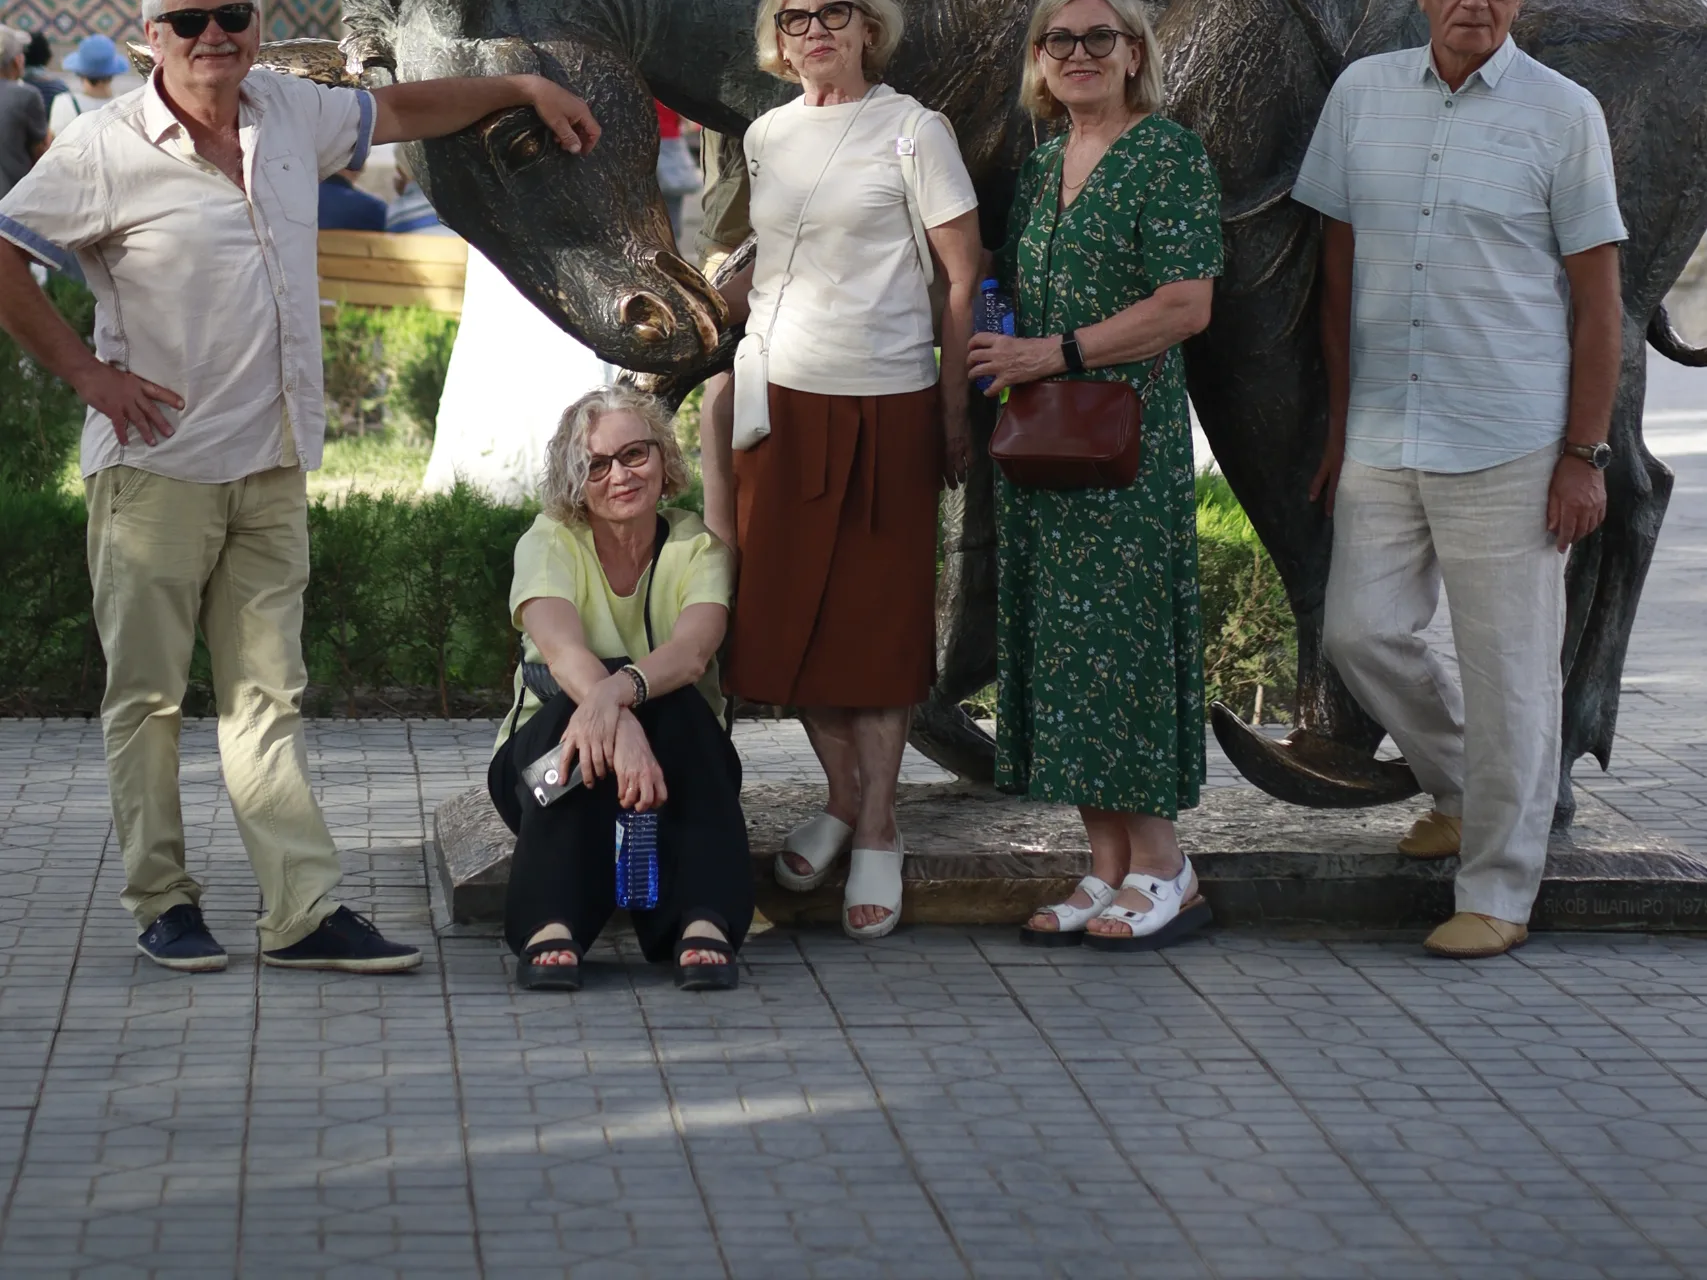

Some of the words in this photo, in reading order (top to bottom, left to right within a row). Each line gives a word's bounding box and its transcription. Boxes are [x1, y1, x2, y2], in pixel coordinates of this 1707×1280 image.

[1544, 898, 1588, 915] ЯКОВ
[1593, 898, 1664, 915] ШАПИРО
[1677, 898, 1707, 915] 197
